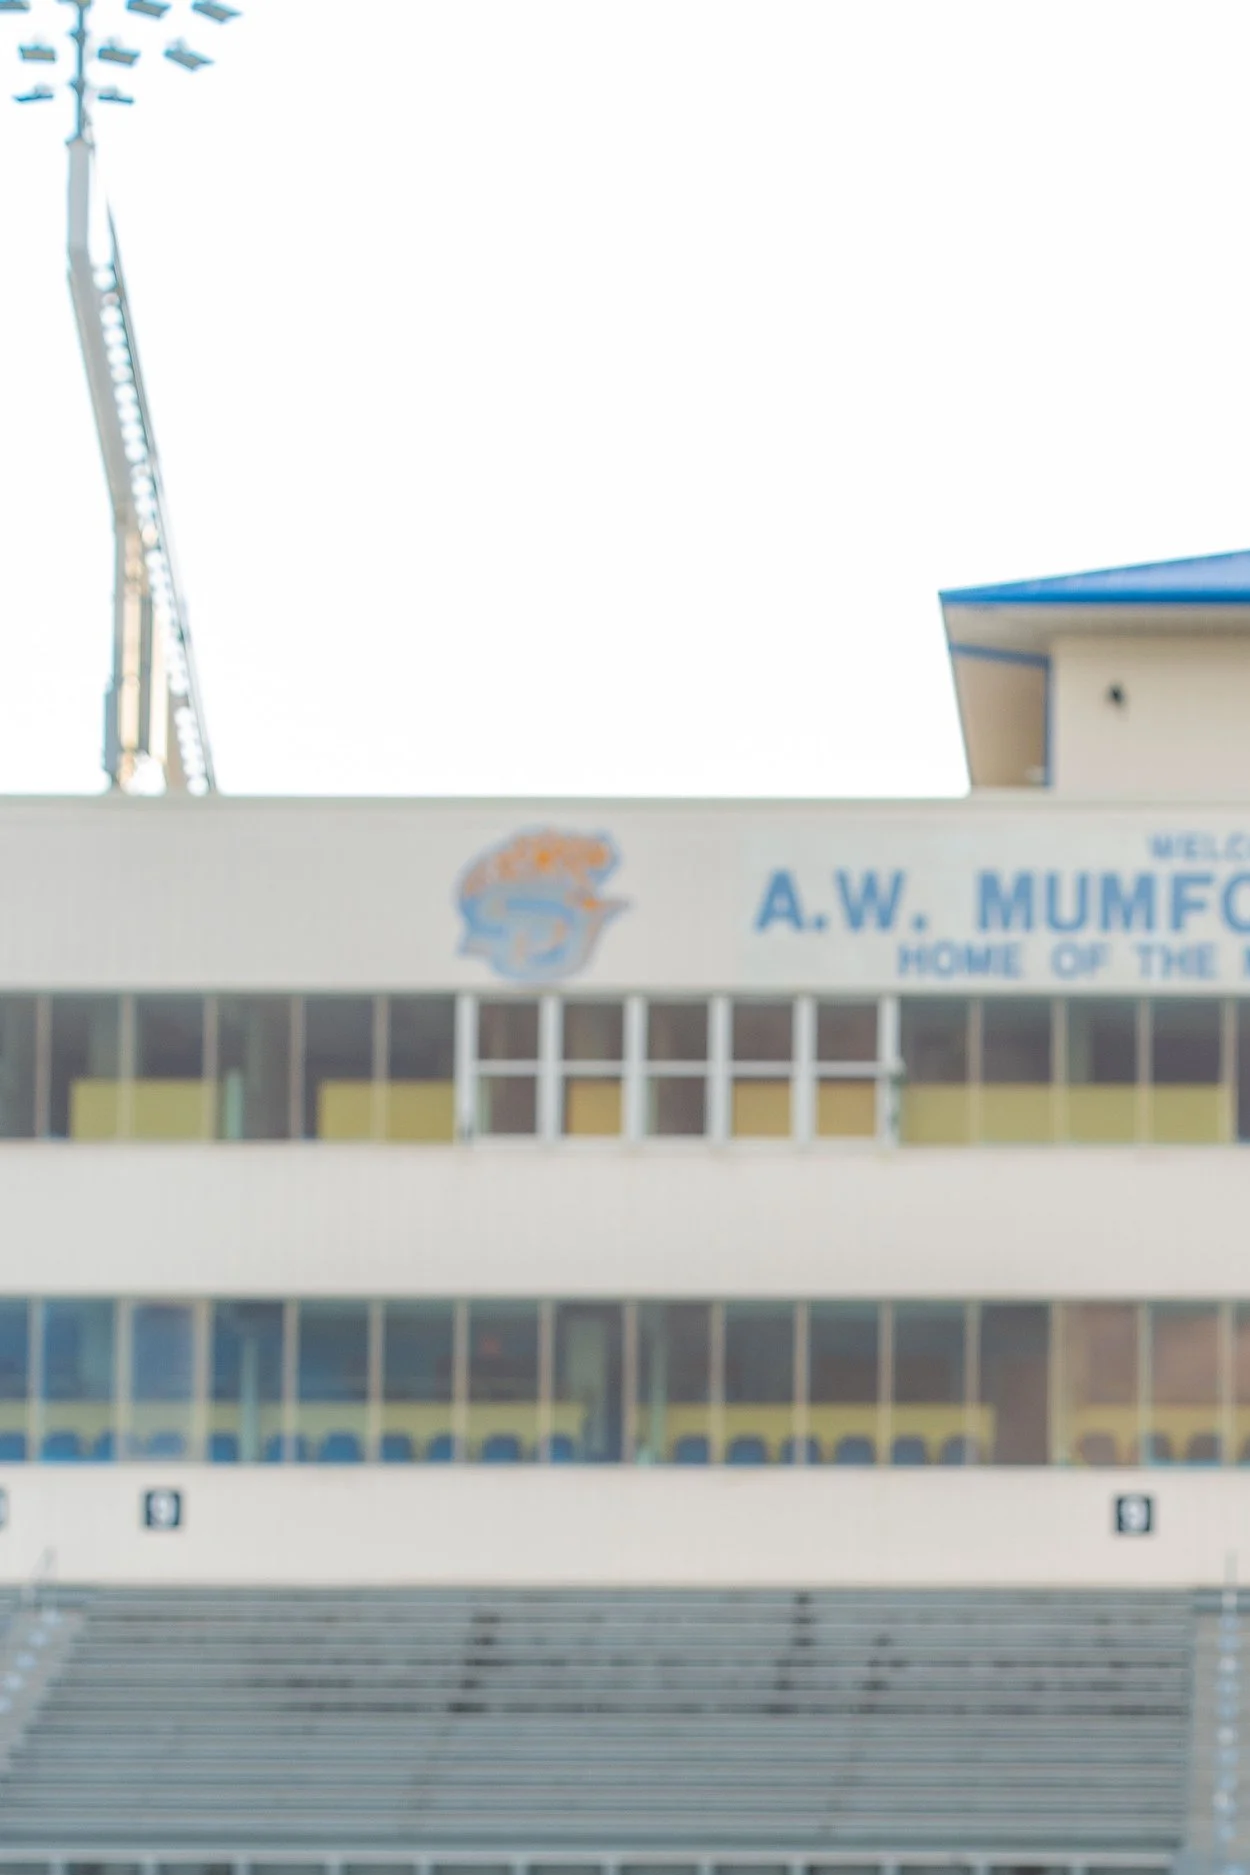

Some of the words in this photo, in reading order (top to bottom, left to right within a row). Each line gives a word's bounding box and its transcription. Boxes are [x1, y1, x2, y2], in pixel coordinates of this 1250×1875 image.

[754, 868, 929, 932] A.W.
[896, 941, 1025, 978] HOME
[1051, 942, 1109, 978] OF
[1136, 944, 1218, 980] THE
